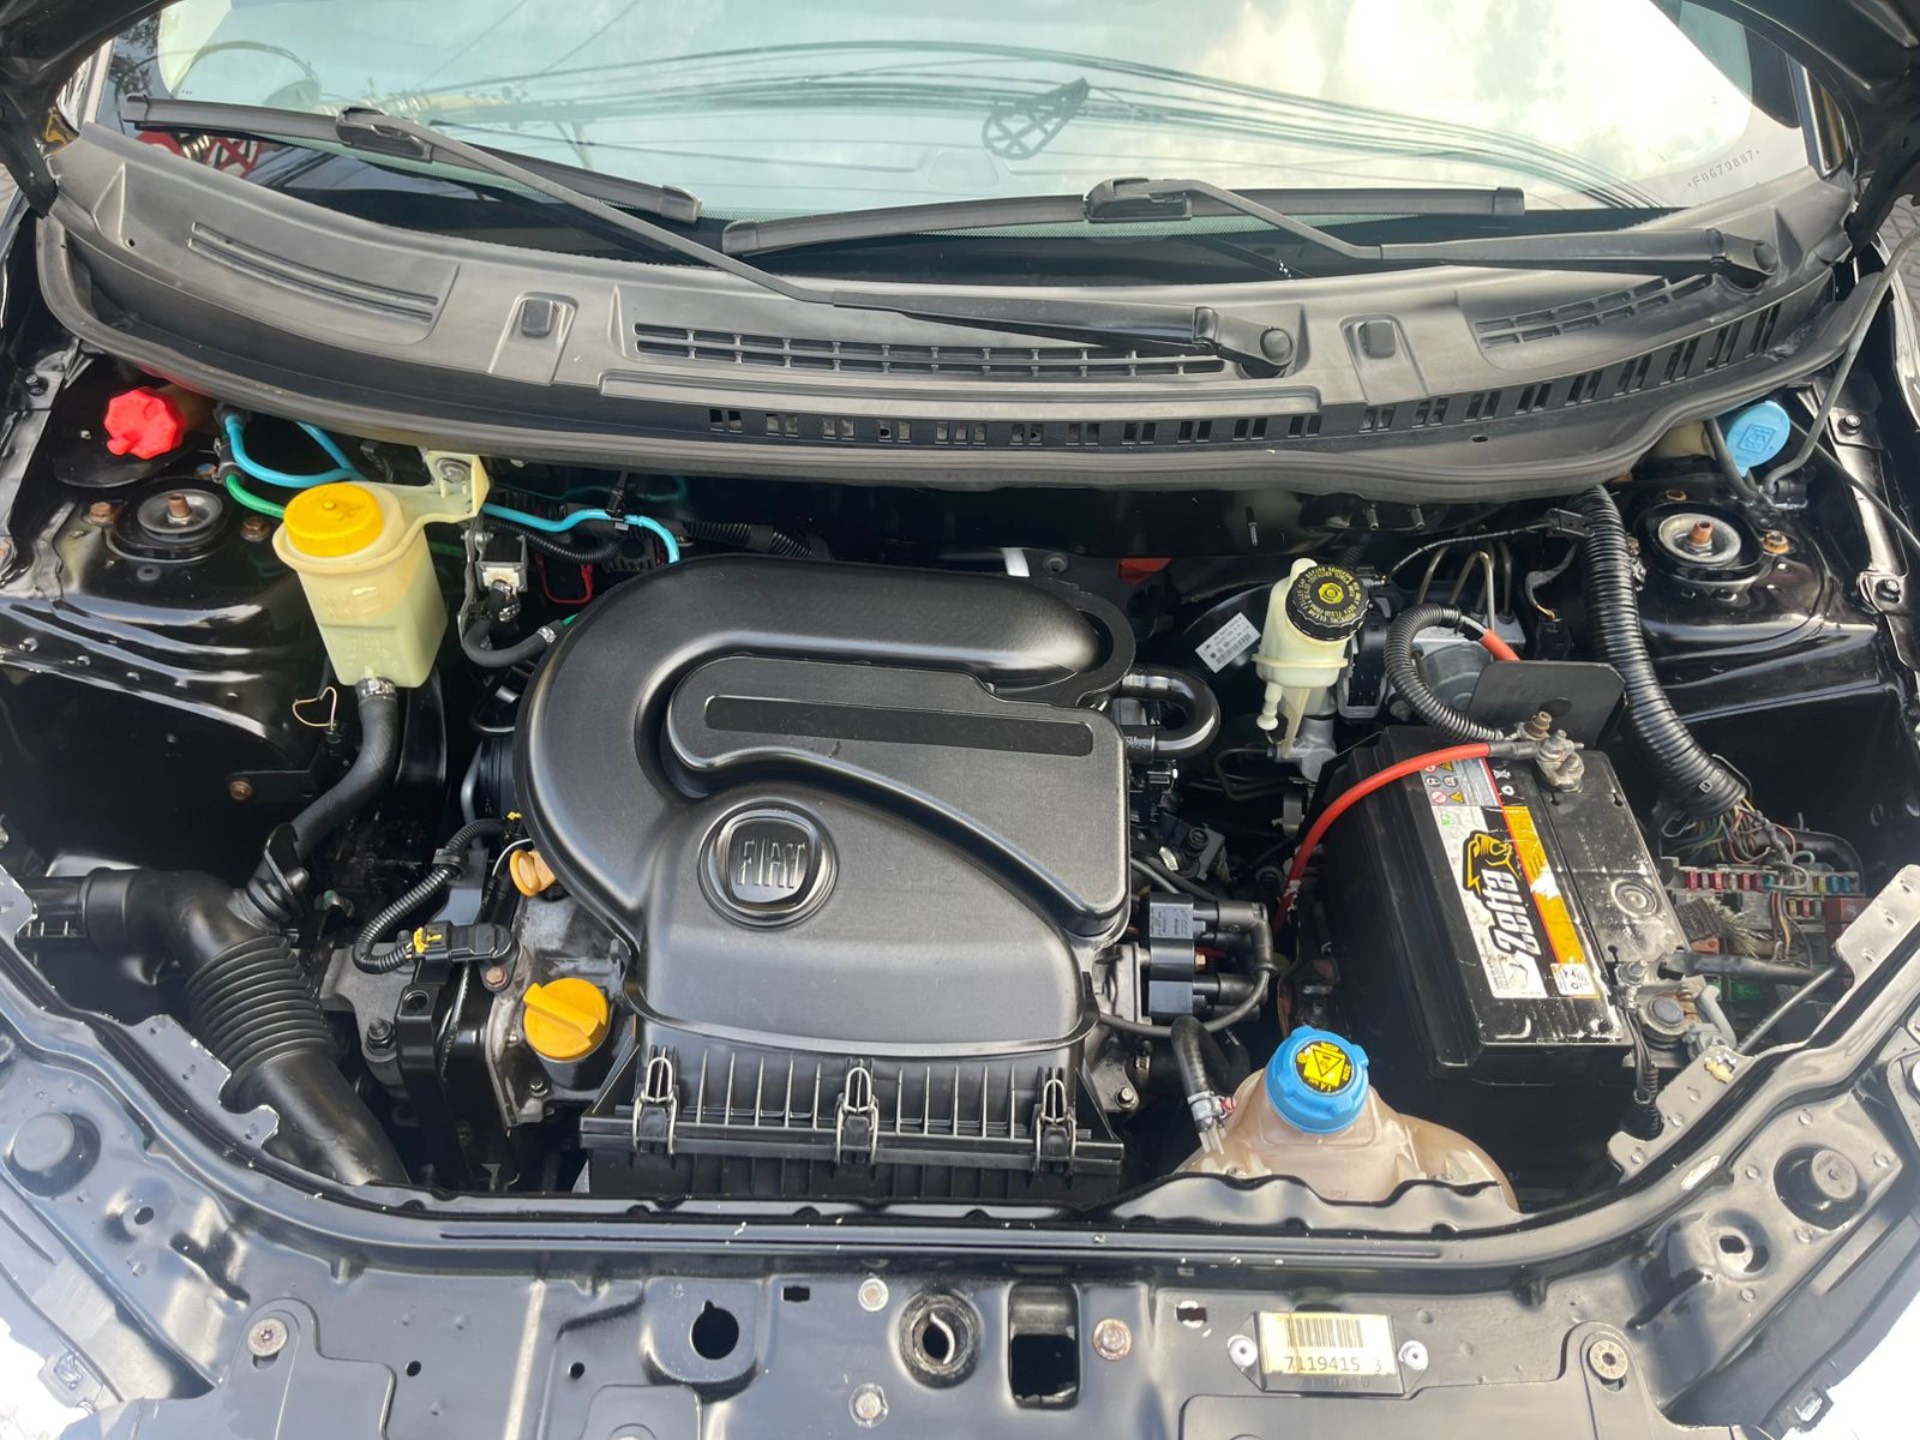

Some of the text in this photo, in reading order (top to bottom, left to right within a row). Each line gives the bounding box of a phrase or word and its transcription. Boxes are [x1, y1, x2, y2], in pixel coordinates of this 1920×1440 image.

[736, 839, 806, 889] FIAT
[1481, 868, 1542, 957] Zetta
[1283, 1355, 1361, 1373] 7119415
